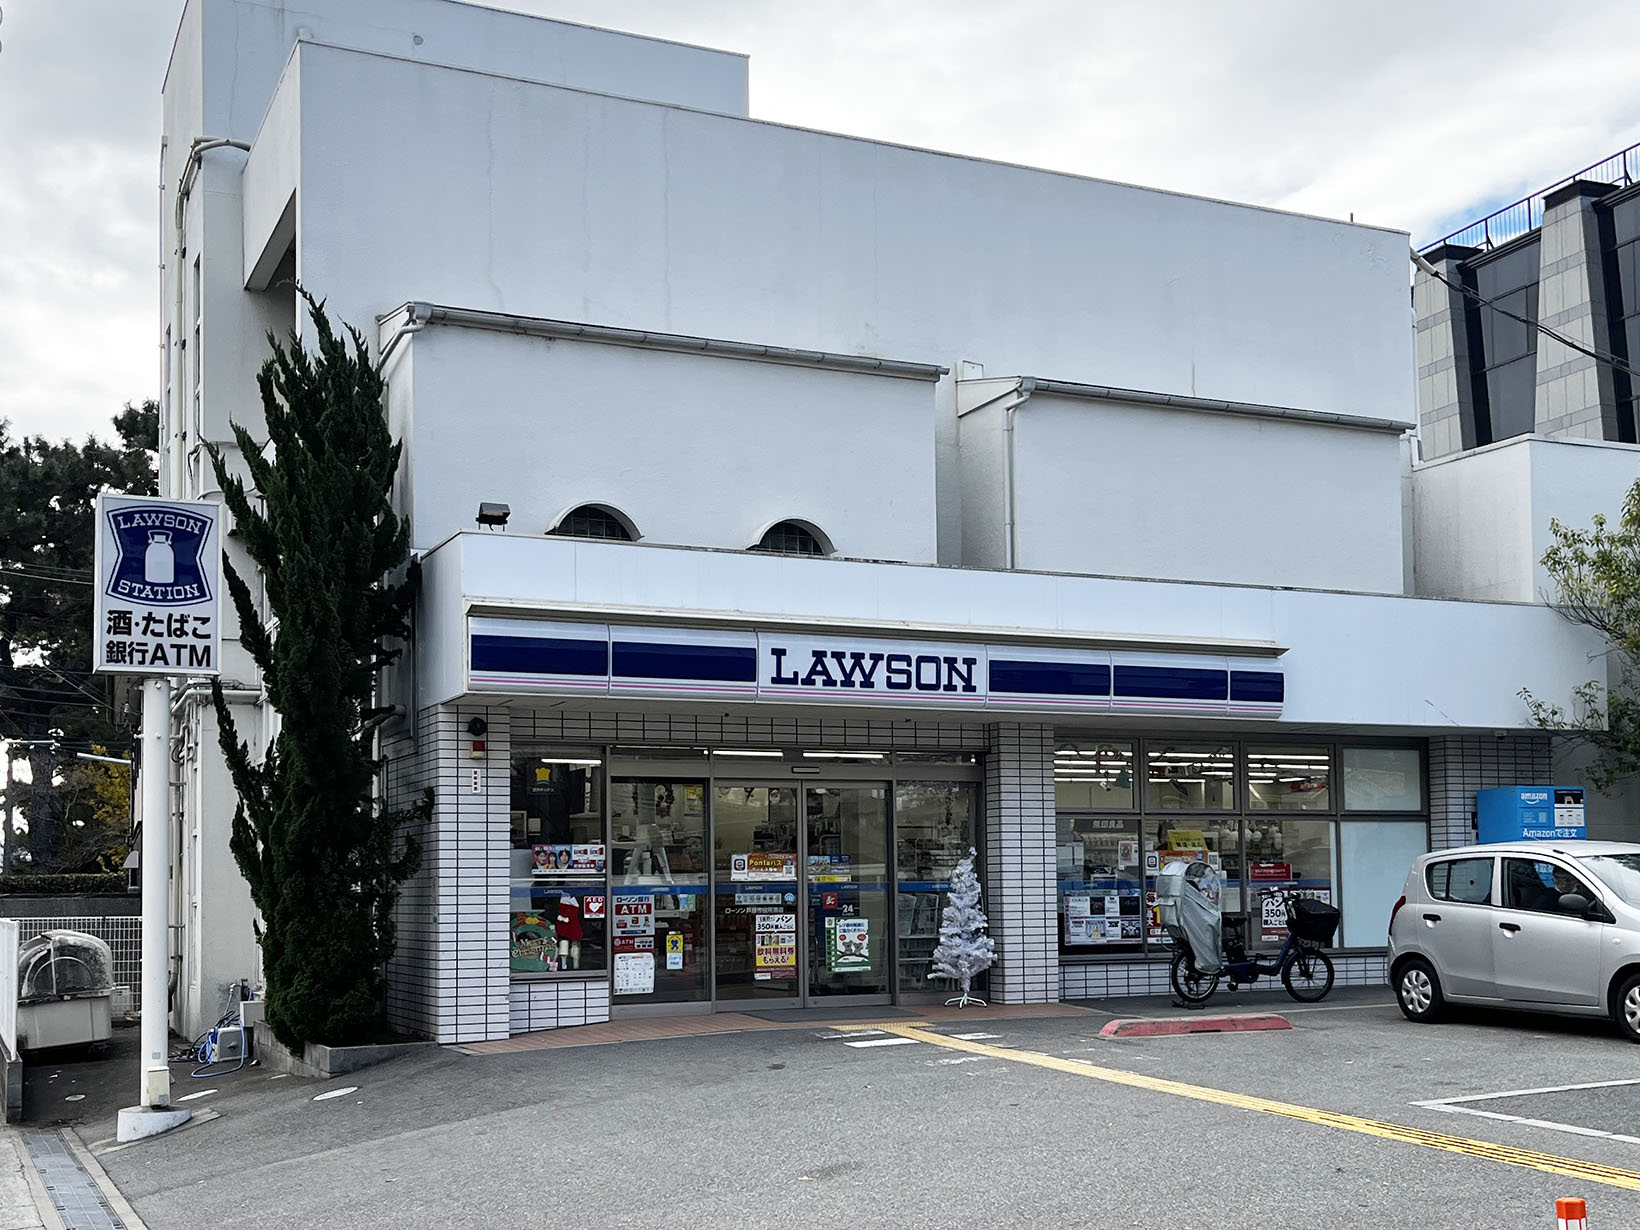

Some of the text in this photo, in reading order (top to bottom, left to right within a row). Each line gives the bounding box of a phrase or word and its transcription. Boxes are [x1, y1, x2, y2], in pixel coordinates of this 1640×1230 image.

[117, 512, 202, 535] LAWSON
[117, 579, 200, 600] STATION
[106, 609, 211, 639] 酒・たばこ
[105, 640, 211, 668] 銀行ATM
[770, 647, 978, 693] LAWSON
[1520, 792, 1548, 801] amazon
[1522, 827, 1578, 838] Amazonで注文
[616, 895, 650, 904] ローソン銀行
[620, 904, 648, 915] ATM
[842, 904, 855, 913] 24
[775, 915, 793, 924] パン
